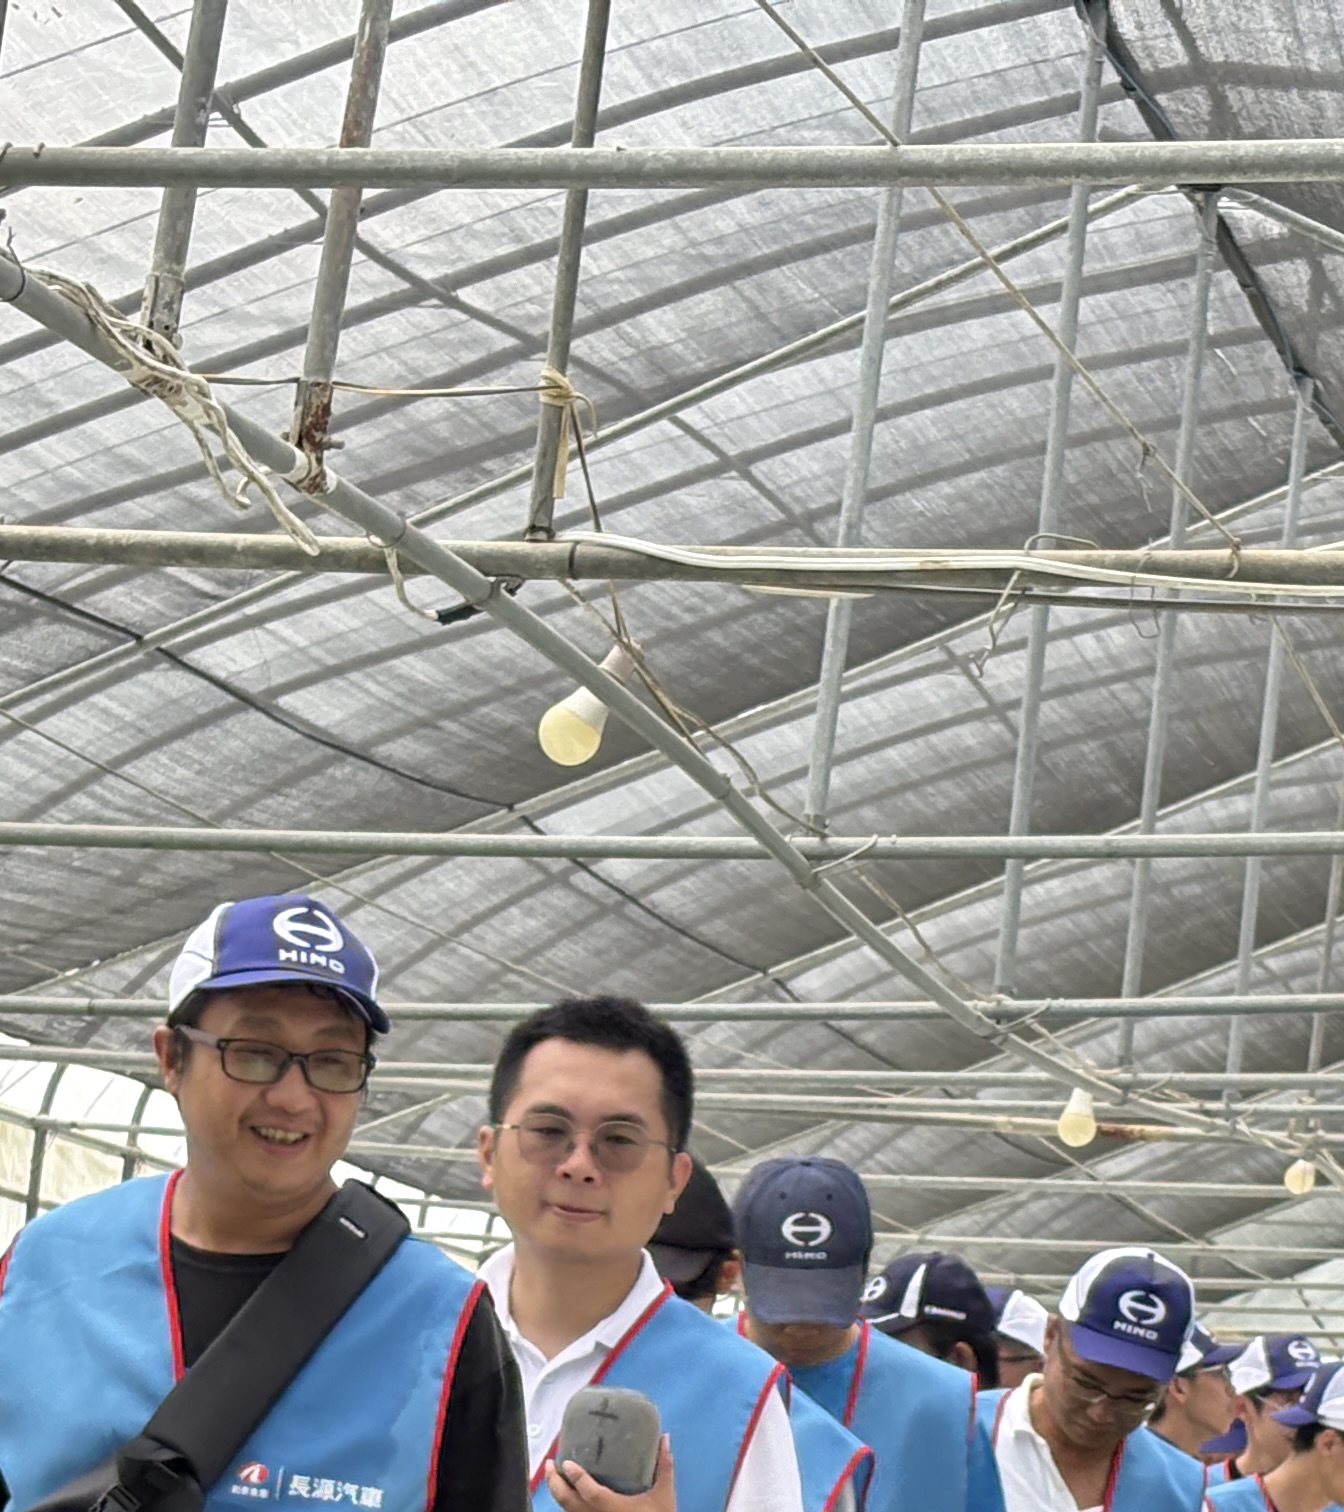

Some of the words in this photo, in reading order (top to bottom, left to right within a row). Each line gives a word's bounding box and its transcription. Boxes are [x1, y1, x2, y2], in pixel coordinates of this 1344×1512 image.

[278, 948, 346, 975] HINO
[785, 1250, 828, 1260] HINO
[1113, 1320, 1159, 1341] HINO
[288, 1474, 384, 1509] 長源汽車
